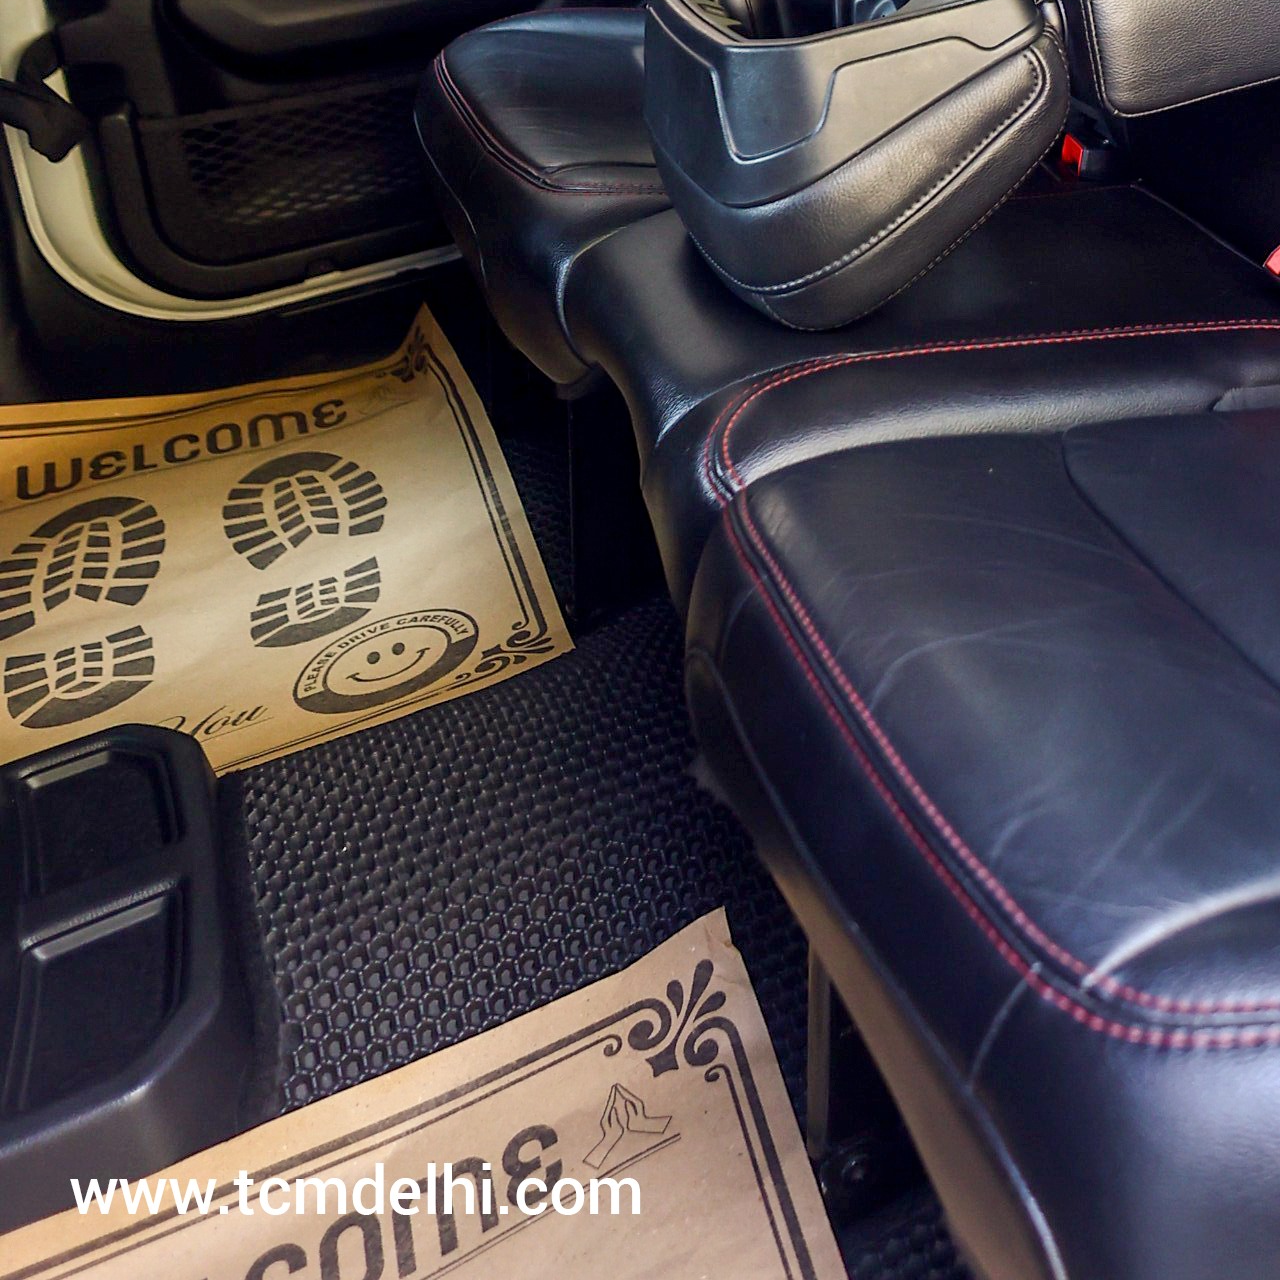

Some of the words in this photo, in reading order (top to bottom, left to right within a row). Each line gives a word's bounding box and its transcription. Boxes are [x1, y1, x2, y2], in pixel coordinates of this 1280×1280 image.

[16, 398, 348, 501] WELCOME
[303, 650, 337, 693] PLEASE
[337, 622, 391, 650] DRIVE
[396, 613, 470, 636] CAREFULLY
